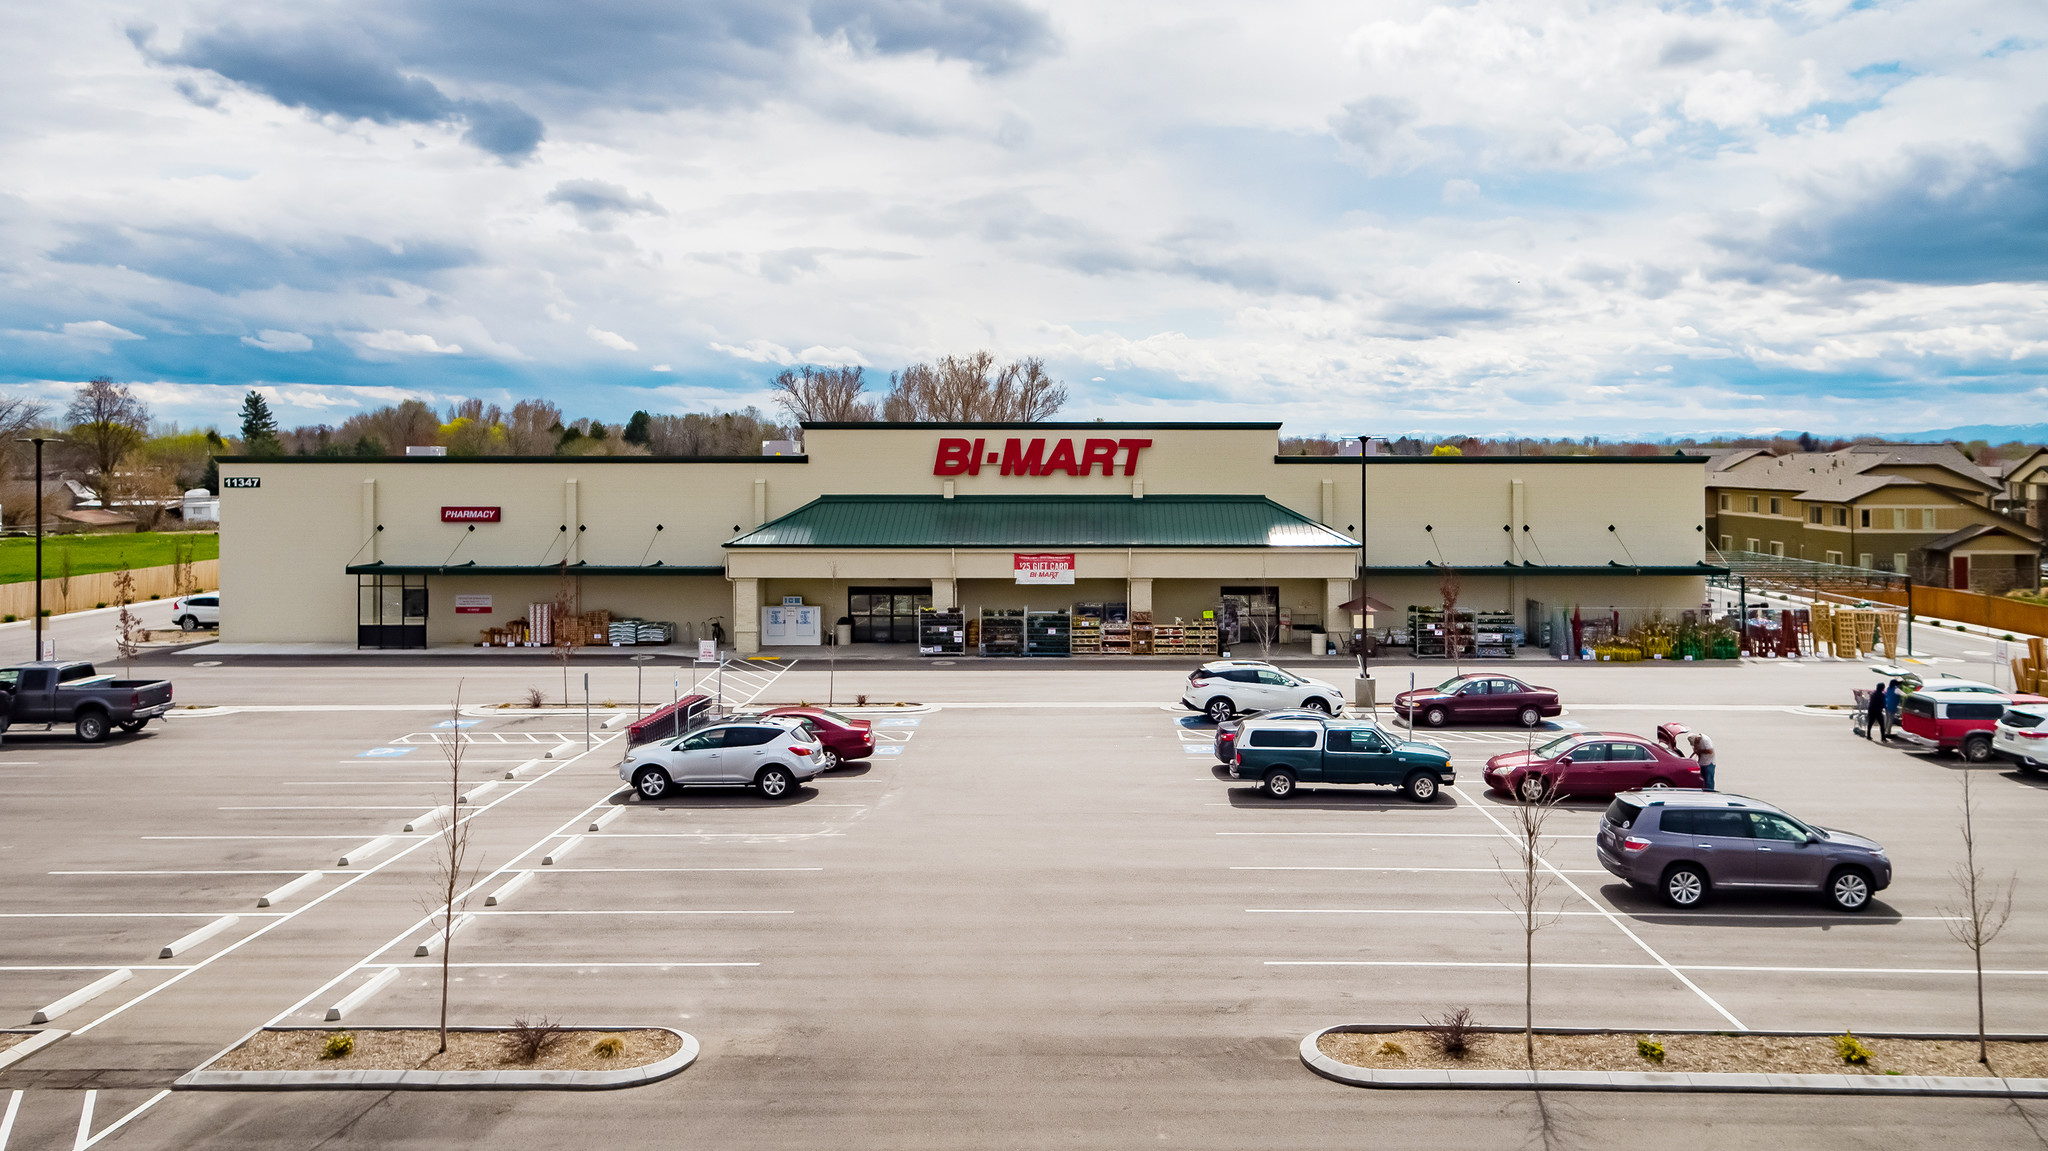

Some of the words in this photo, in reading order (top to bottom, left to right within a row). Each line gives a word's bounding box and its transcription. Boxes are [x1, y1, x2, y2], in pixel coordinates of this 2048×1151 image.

[225, 478, 259, 487] 11347
[445, 510, 495, 518] PHARMACY
[1032, 562, 1048, 570] GIFT
[1050, 562, 1069, 570] CARD
